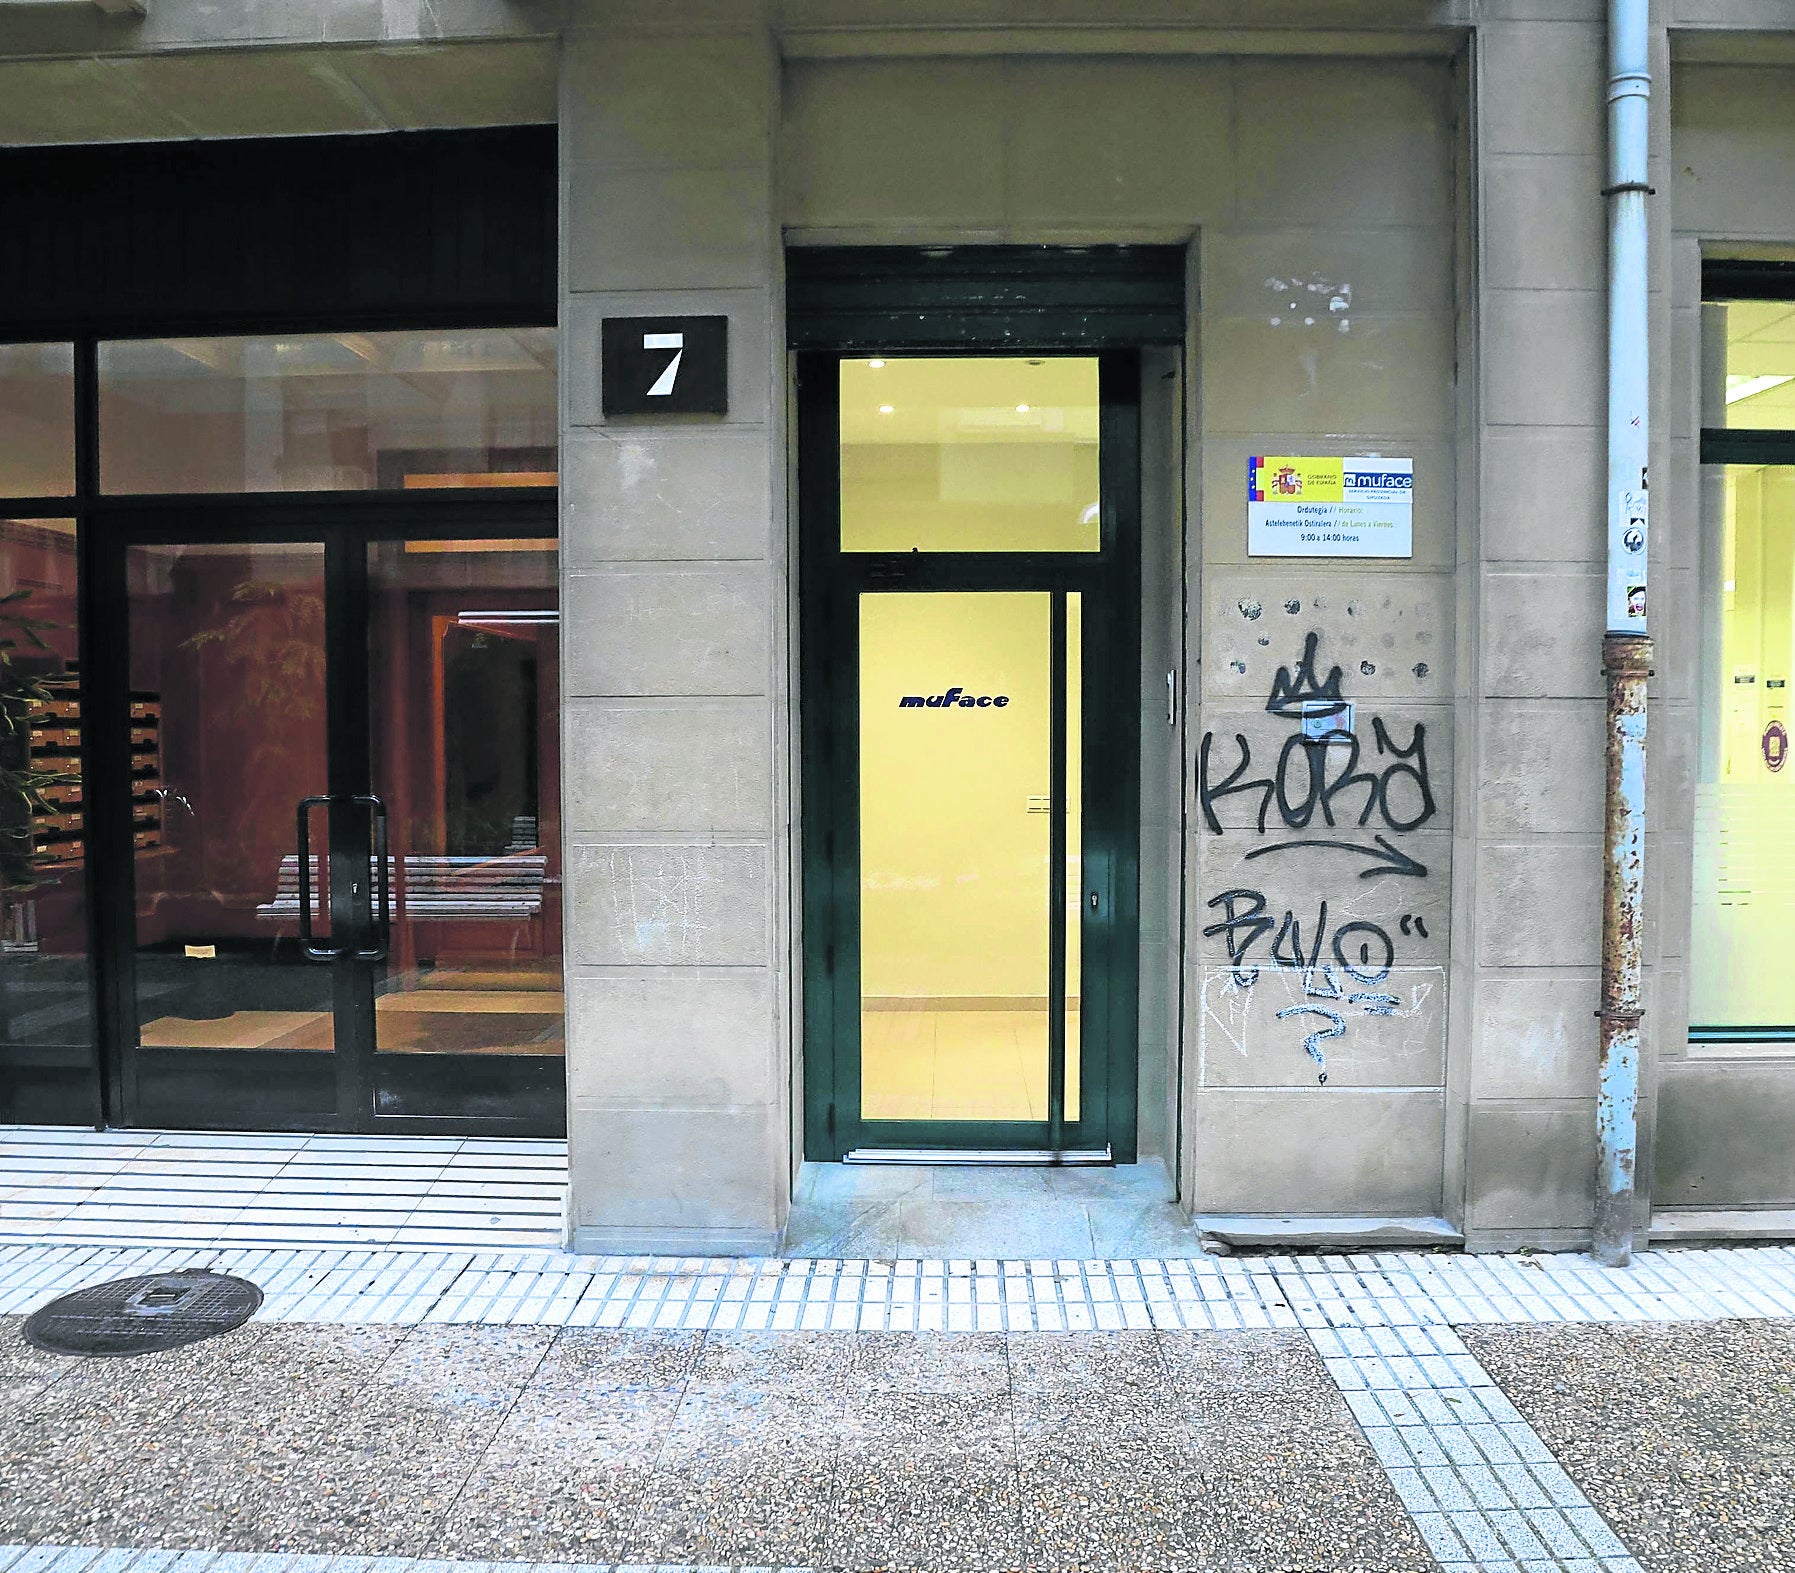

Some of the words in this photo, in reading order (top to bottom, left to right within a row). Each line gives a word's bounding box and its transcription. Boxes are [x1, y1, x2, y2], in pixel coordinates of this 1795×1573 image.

[643, 333, 684, 396] 7
[1357, 473, 1412, 488] muface
[1297, 505, 1328, 515] Ordutegia
[1304, 519, 1332, 527] Ostiralera
[1300, 533, 1315, 542] 9:00
[1322, 533, 1341, 542] 14:00
[1342, 533, 1360, 542] horas
[899, 687, 1010, 708] muface
